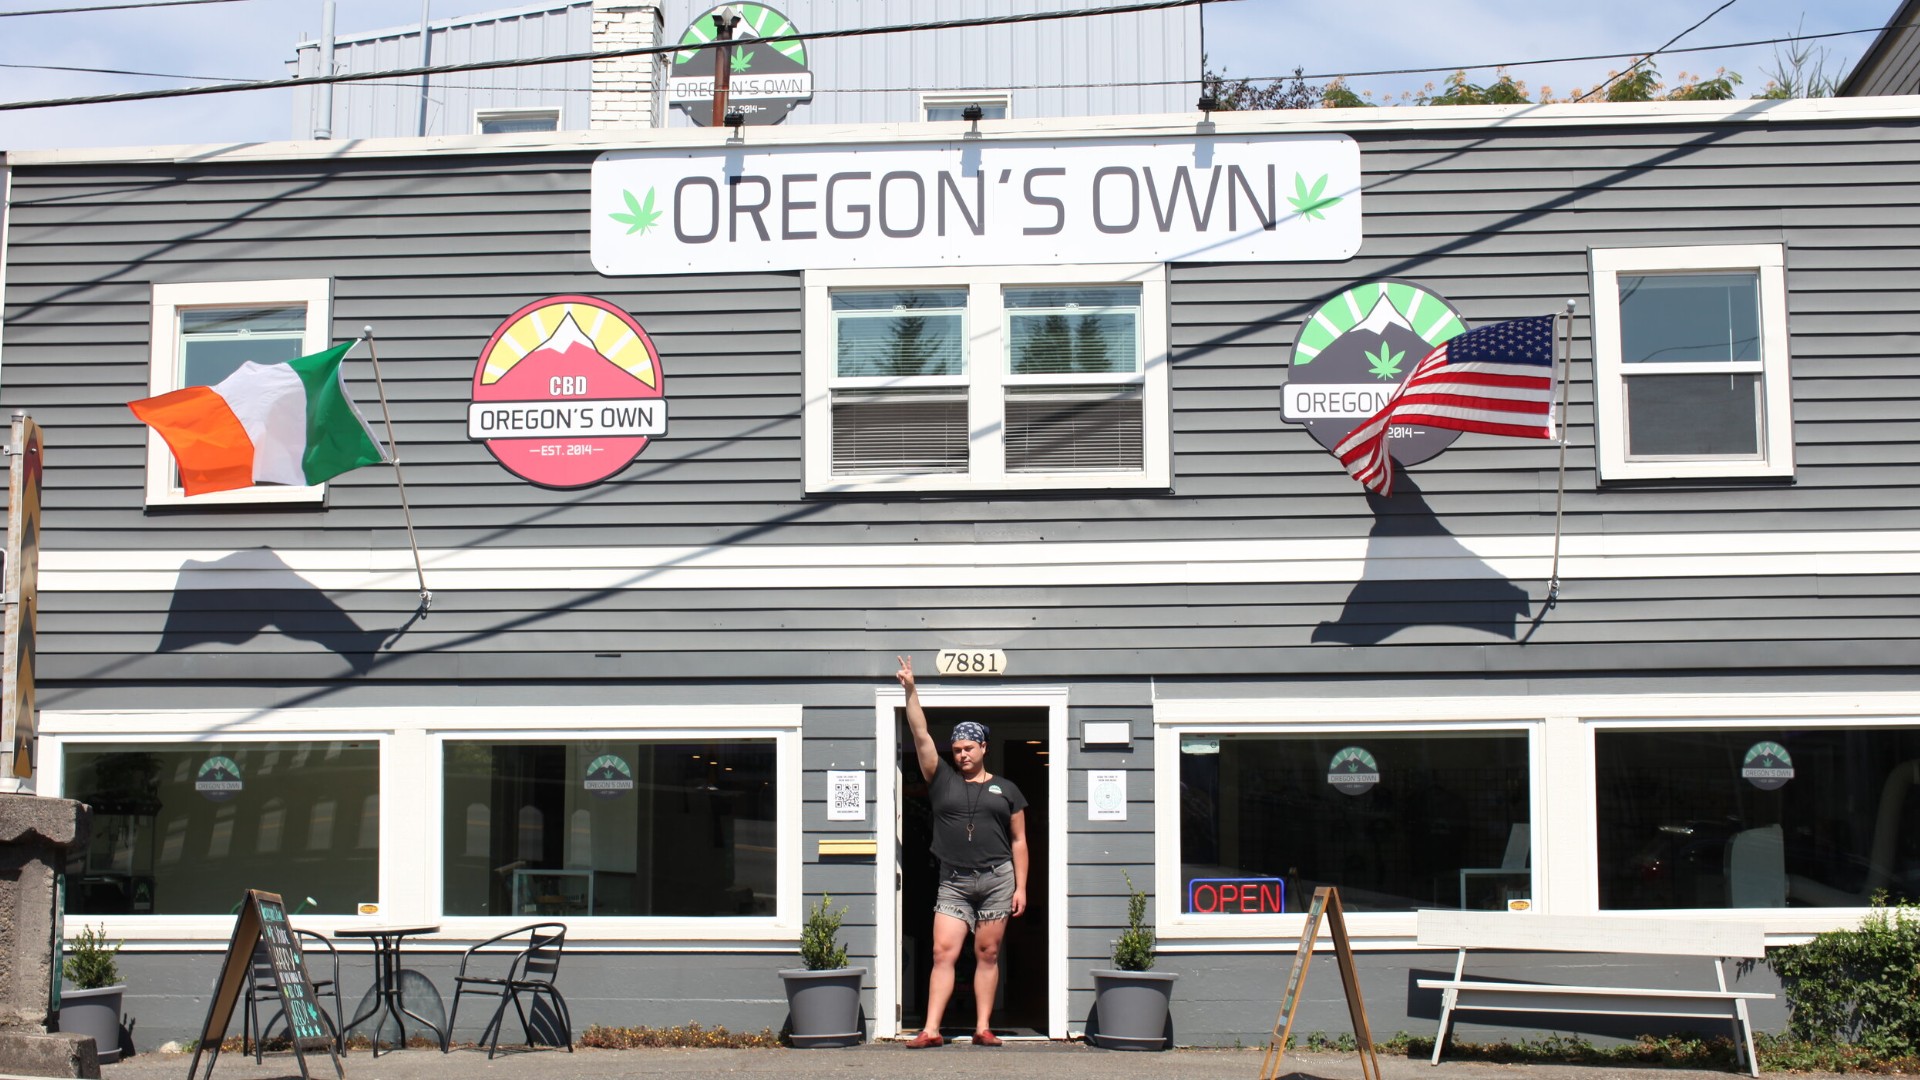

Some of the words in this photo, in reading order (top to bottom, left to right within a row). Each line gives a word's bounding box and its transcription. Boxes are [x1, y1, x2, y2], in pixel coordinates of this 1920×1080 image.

[676, 79, 759, 98] OREGN'S
[763, 78, 803, 95] OWN
[738, 104, 758, 114] 2014
[672, 167, 1066, 244] OREGON'S
[1092, 164, 1277, 236] OWN
[549, 375, 587, 396] CBD
[1296, 391, 1391, 413] OREGON
[480, 408, 594, 431] OREGON'S
[601, 406, 654, 428] OWN
[1388, 427, 1412, 438] 2014
[944, 653, 998, 672] 7881
[1194, 884, 1280, 913] OPEN
